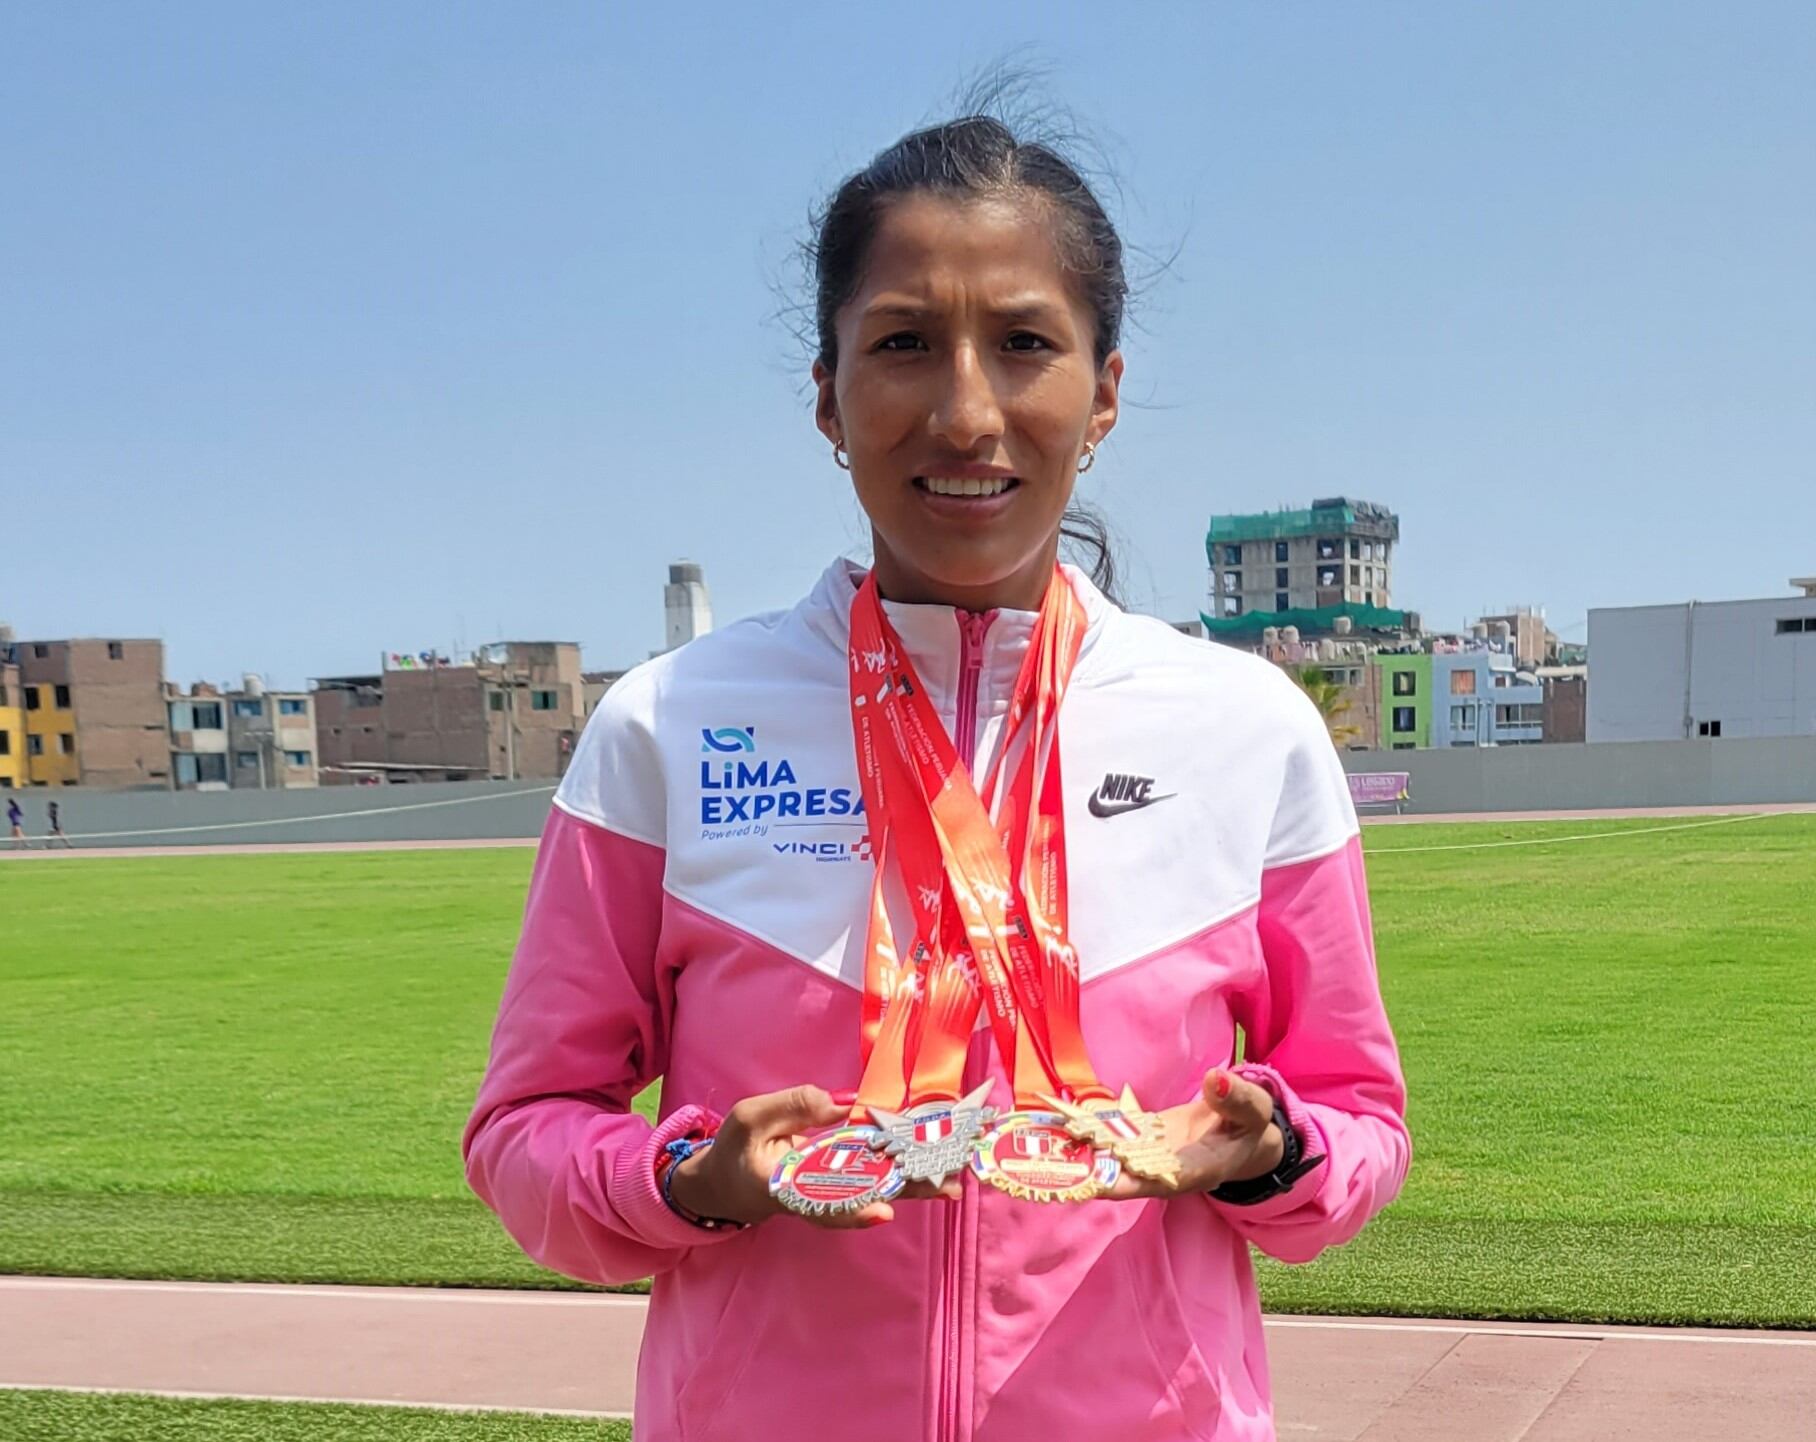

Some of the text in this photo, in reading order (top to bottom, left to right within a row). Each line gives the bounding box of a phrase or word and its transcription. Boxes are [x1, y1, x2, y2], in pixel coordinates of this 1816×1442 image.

[1099, 773, 1155, 802] NIKE
[701, 824, 769, 841] Powered by
[773, 842, 845, 855] VINCI
[990, 1175, 1052, 1203] GRAN
